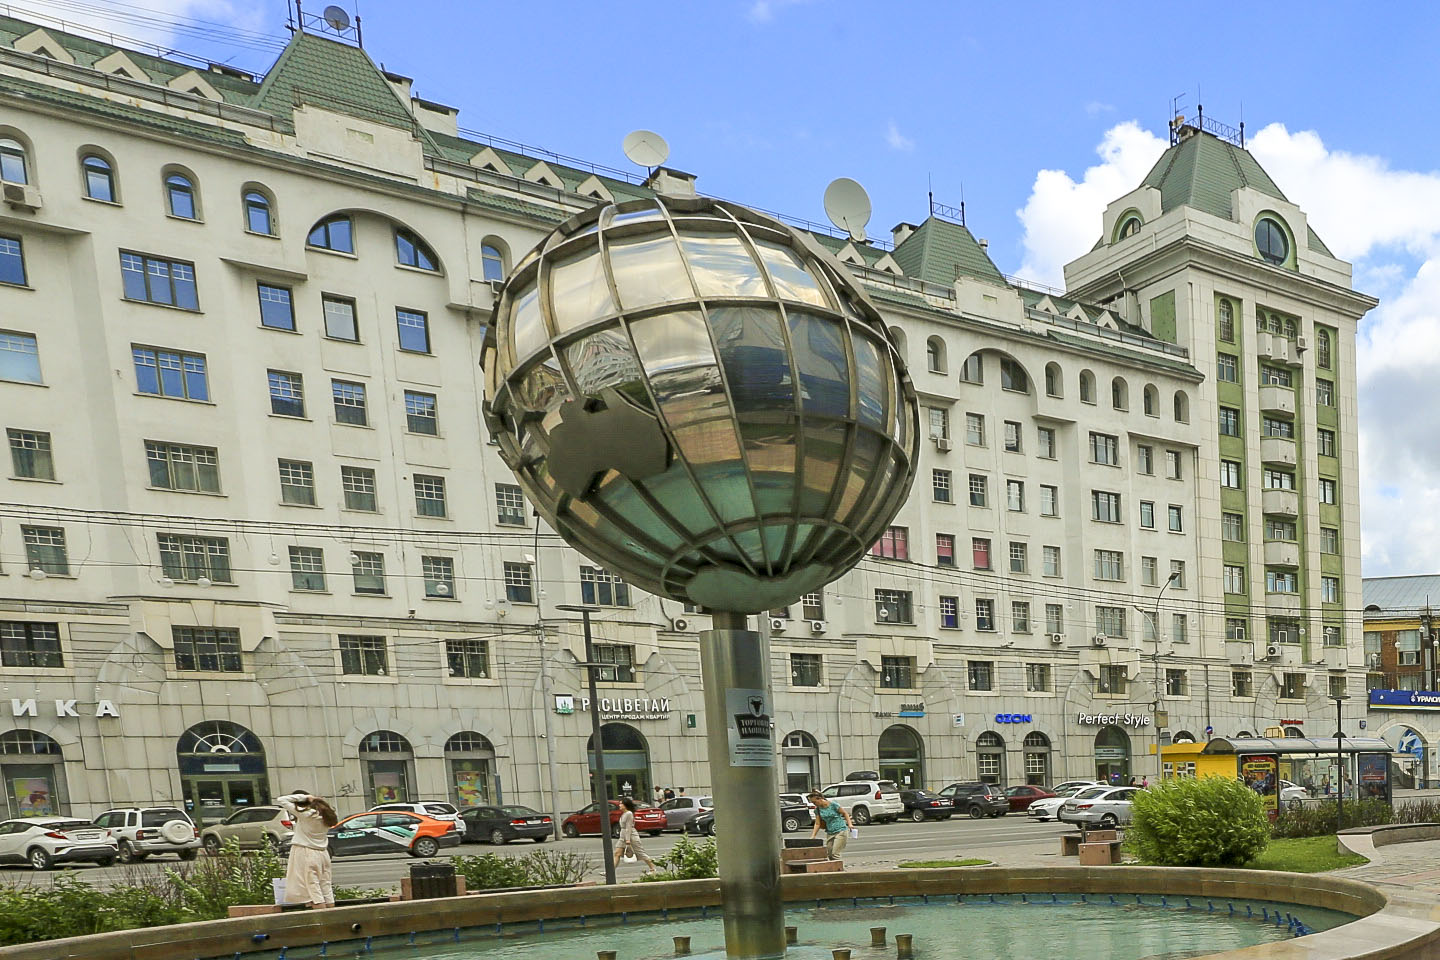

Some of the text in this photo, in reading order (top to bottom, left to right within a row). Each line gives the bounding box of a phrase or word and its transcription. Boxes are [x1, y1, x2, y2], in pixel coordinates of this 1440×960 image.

[581, 696, 670, 714] РСЦВЕТАЙ
[995, 714, 1033, 724] OZON
[1078, 712, 1151, 729] Perfect Style
